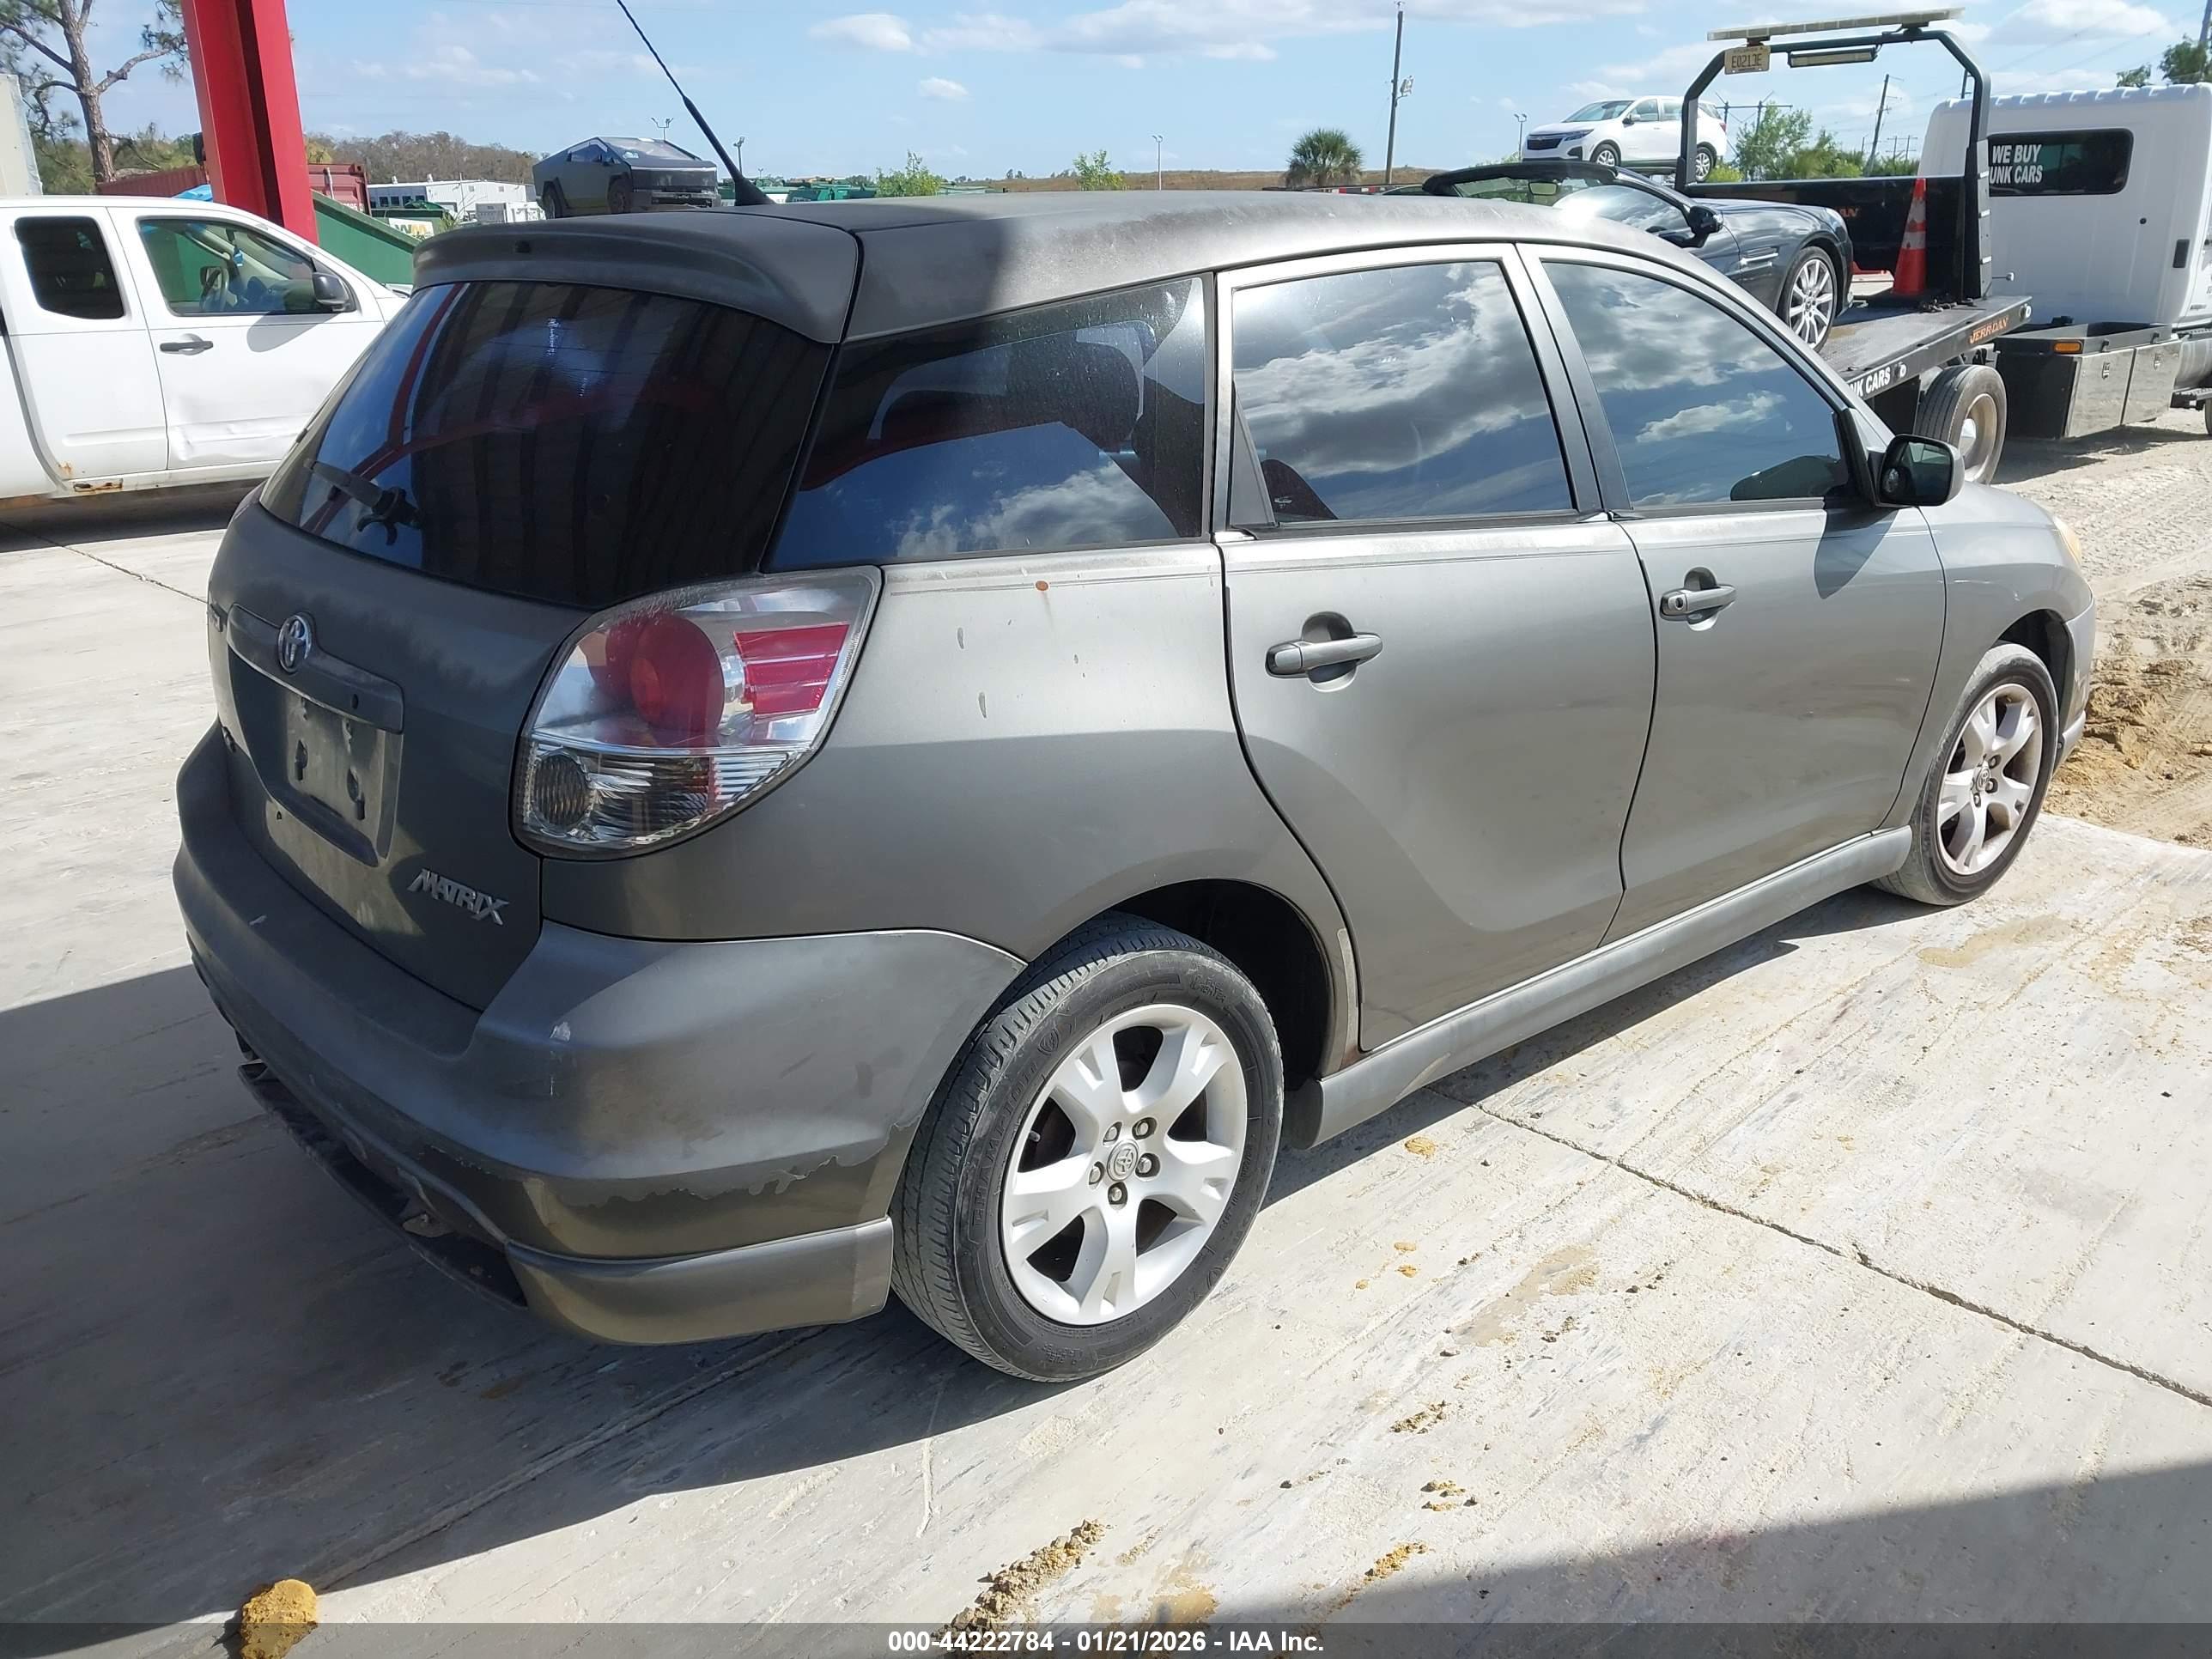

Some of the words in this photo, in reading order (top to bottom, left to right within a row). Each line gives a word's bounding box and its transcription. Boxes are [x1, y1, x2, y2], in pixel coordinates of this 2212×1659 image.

[1992, 144, 2012, 164] WE
[2014, 144, 2042, 163] BUY
[1989, 166, 2013, 184] UNK
[2014, 165, 2043, 183] CARS
[1865, 367, 1891, 394] CARS
[407, 867, 509, 926] MATRIX
